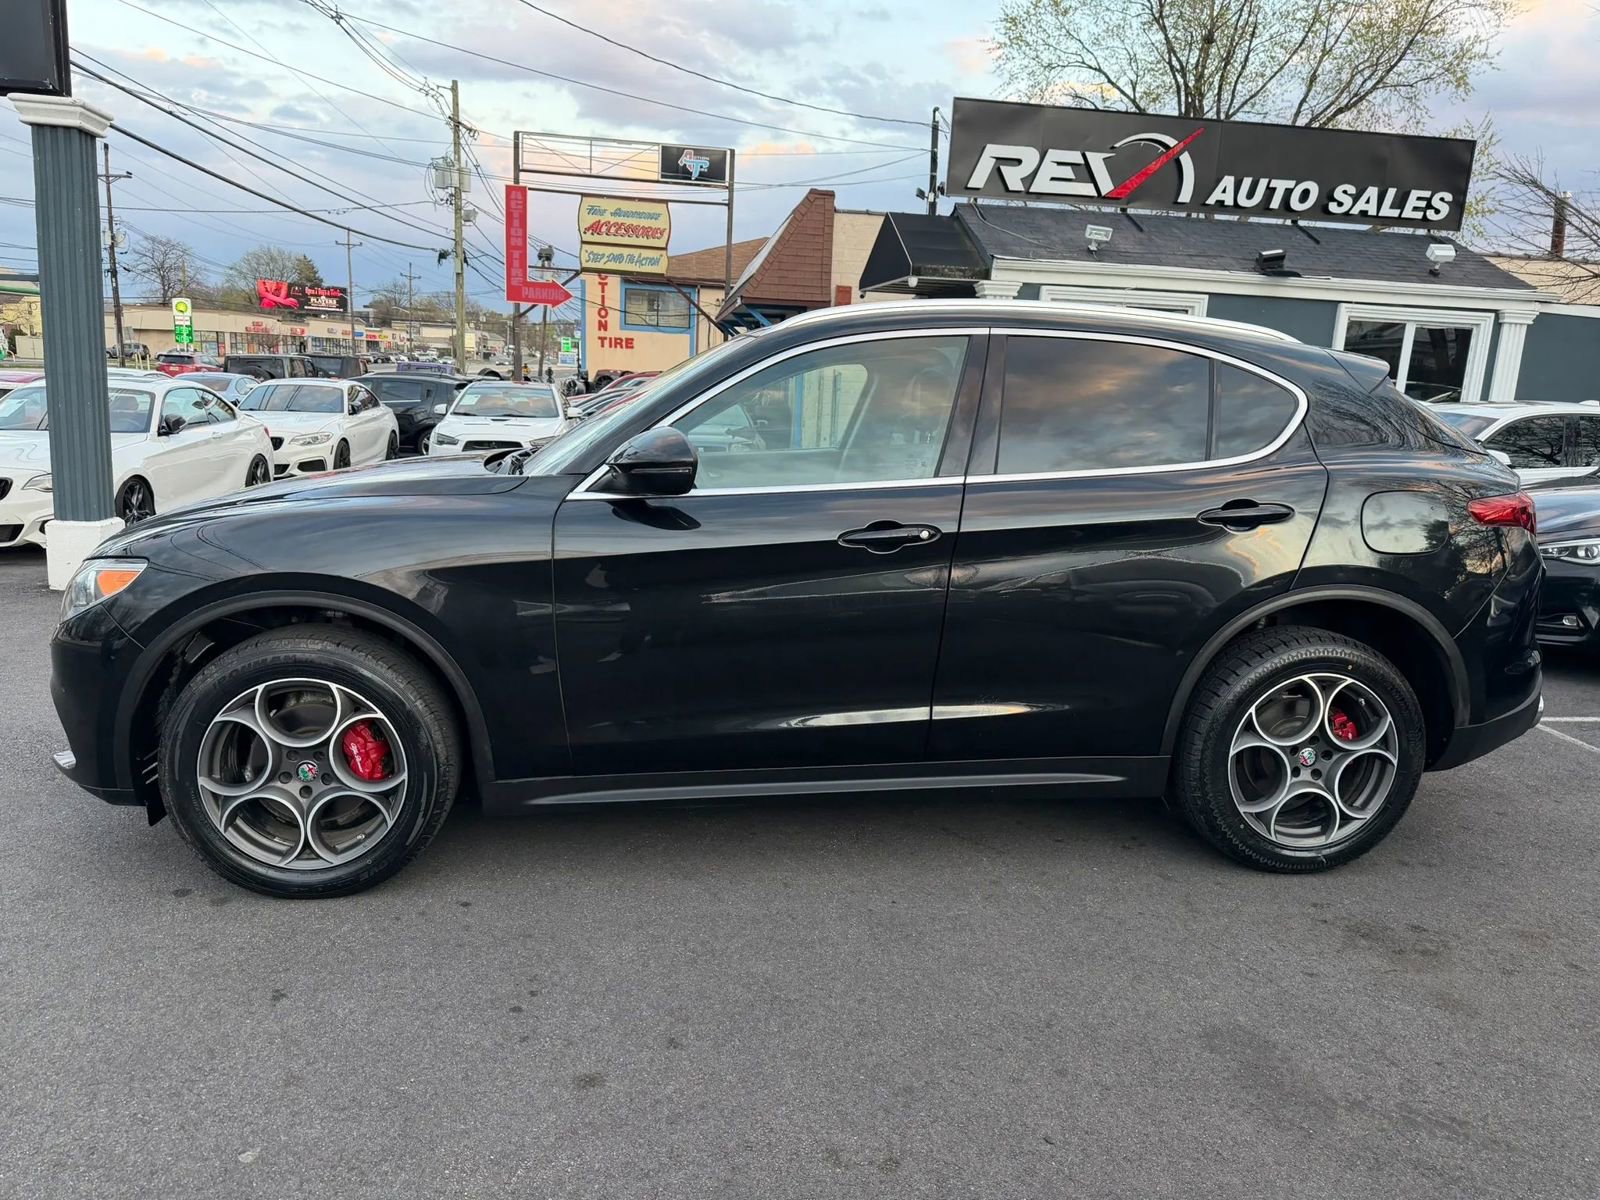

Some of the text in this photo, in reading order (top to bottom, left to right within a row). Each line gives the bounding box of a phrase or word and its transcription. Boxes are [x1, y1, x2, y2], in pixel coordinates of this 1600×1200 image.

[966, 128, 1453, 221] REV AUTO SALES
[510, 190, 523, 286] ACTION TIRE
[583, 219, 667, 239] ACCESSORIES
[521, 286, 565, 300] PARKING
[597, 336, 634, 349] TIRE
